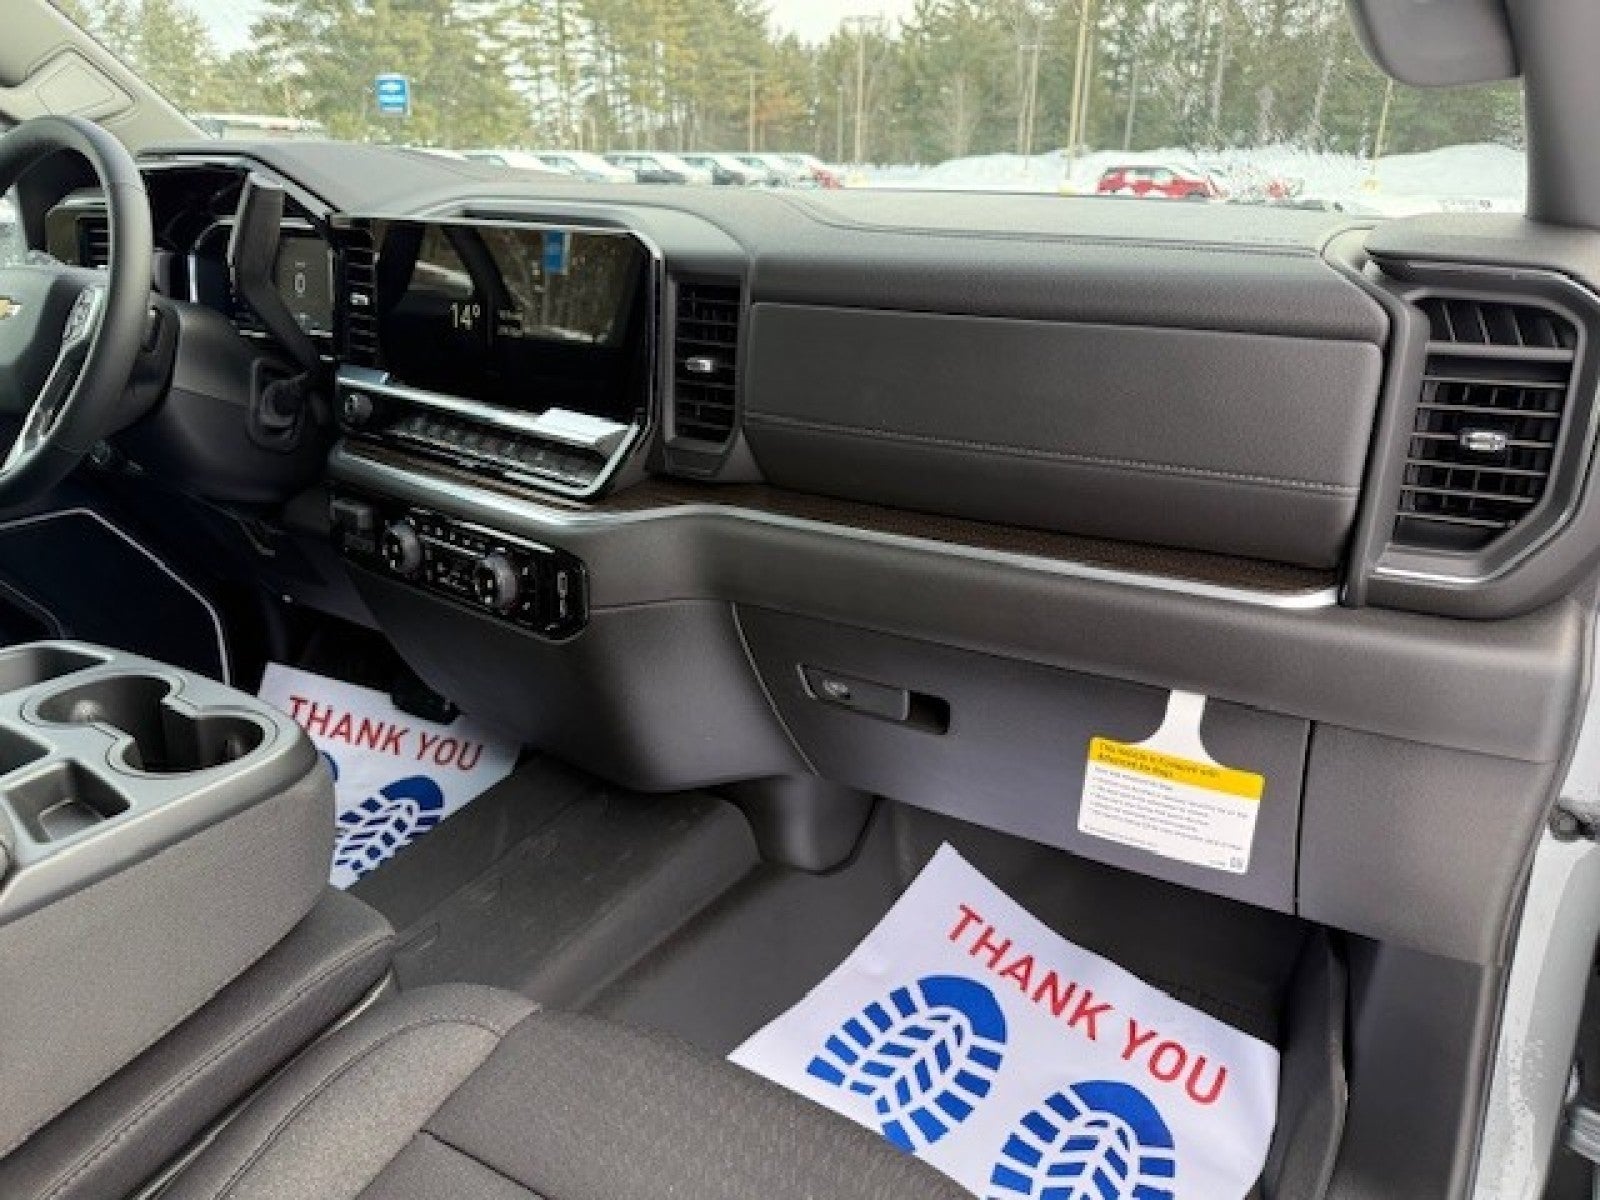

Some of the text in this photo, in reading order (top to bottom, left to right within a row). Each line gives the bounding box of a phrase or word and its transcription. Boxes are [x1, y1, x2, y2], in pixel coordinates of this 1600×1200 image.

[290, 695, 484, 770] THANK YOU
[947, 903, 1229, 1105] THANK YOU
